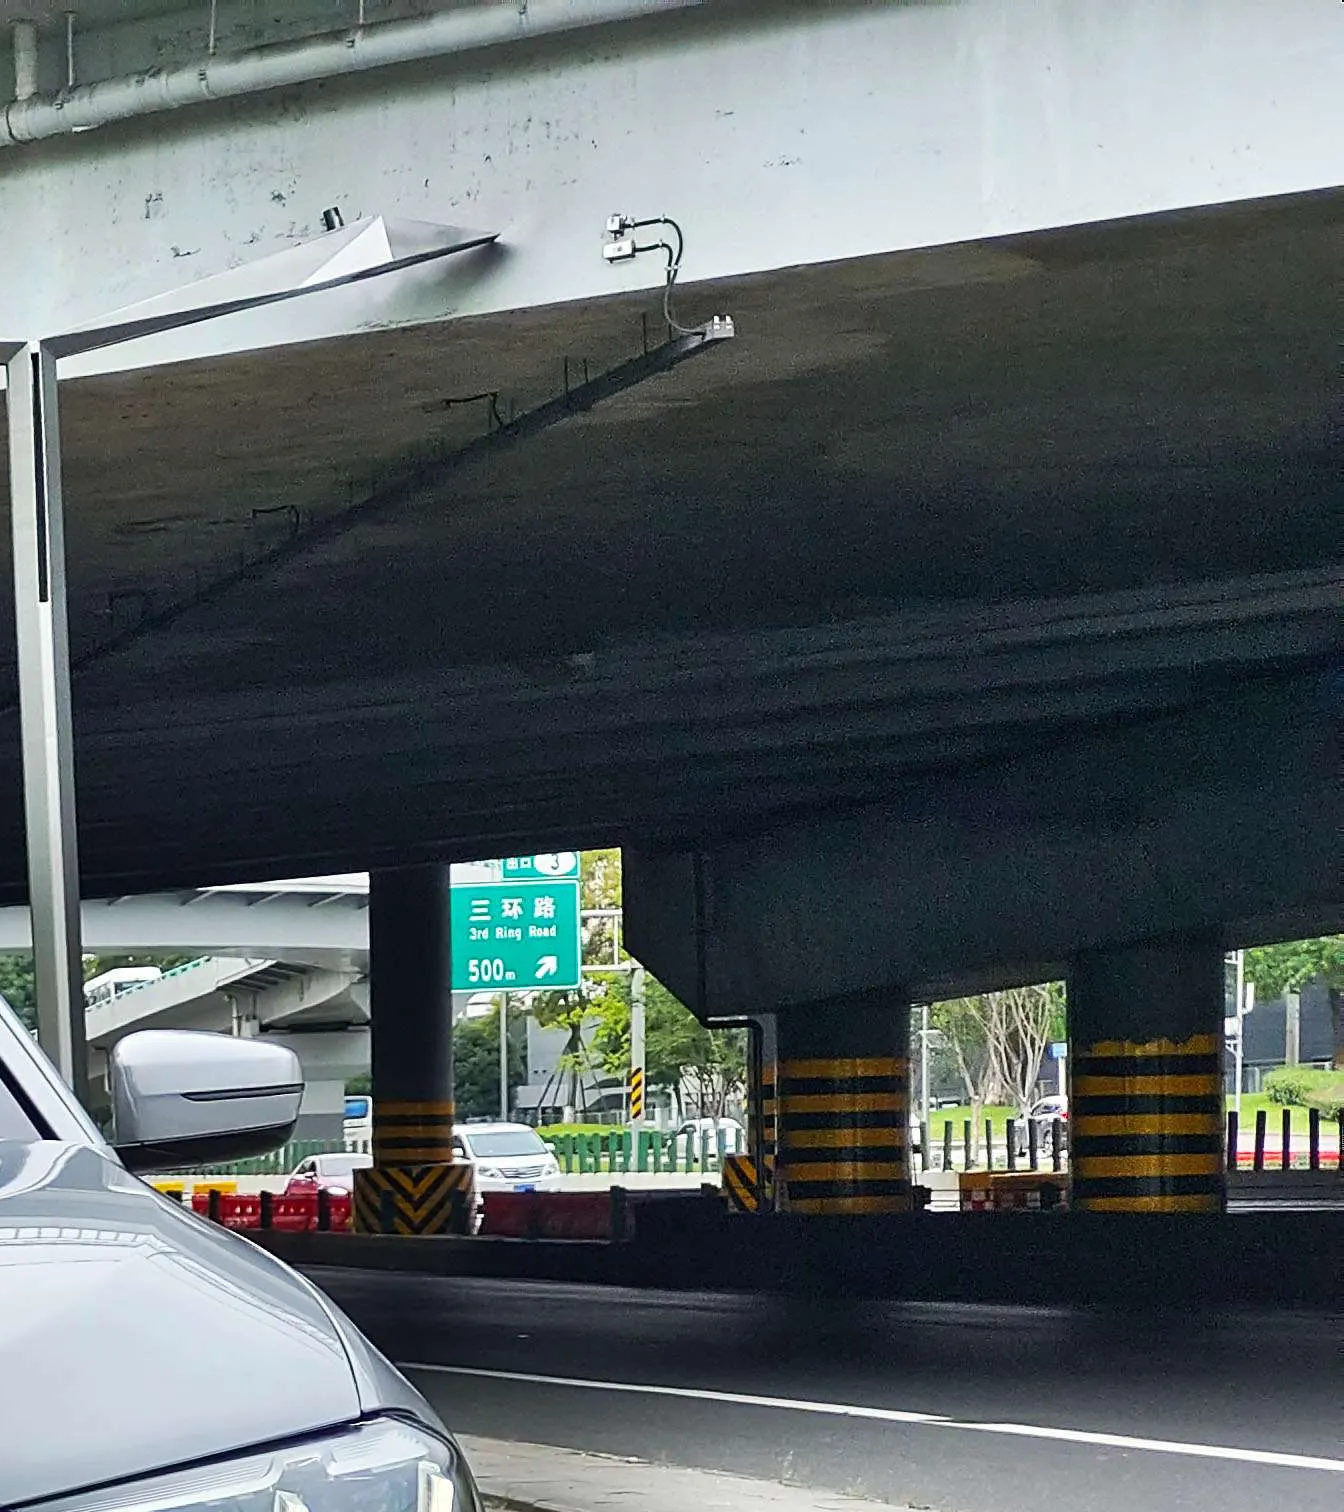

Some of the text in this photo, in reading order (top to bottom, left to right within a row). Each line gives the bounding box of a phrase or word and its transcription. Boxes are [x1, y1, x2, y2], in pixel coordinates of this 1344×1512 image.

[550, 853, 560, 870] 3
[469, 896, 556, 921] 三环路
[469, 924, 557, 941] 3rd Ring Road
[468, 958, 517, 983] 500m
